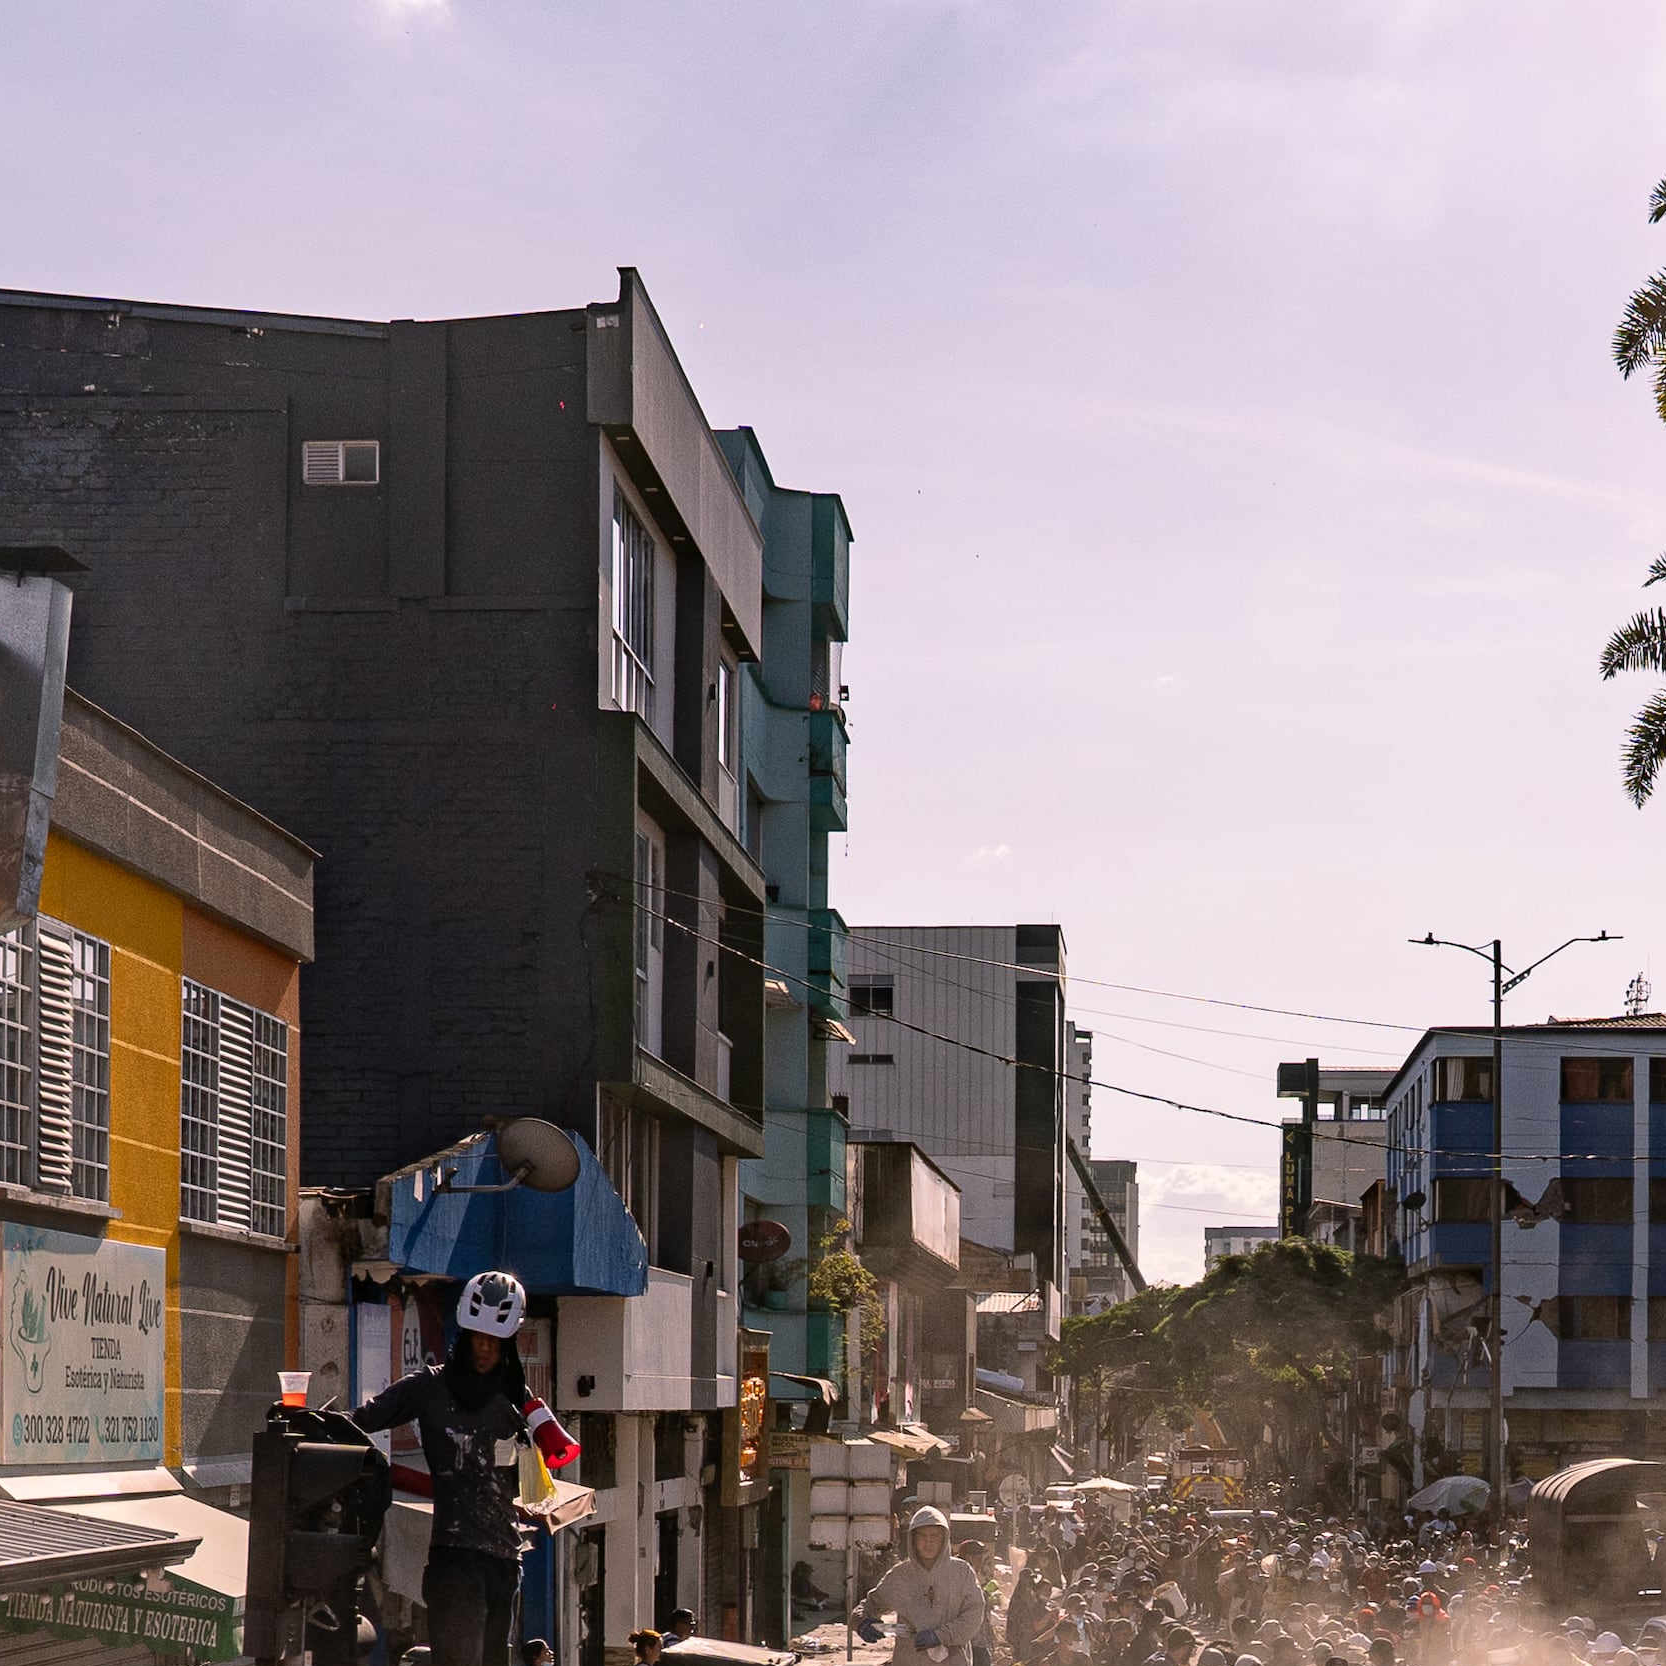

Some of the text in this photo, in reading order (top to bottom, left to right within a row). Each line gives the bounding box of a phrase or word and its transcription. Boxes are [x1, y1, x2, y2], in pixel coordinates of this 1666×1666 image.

[46, 1266, 162, 1336] Vive Natural Live
[90, 1336, 122, 1361] TIENDA
[65, 1365, 145, 1395] Esotérica y Naturista
[23, 1414, 159, 1444] 300 328 4722 321 752 1130
[72, 1578, 142, 1601] RODUCTOS
[6, 1591, 218, 1648] TIENDA NATURISTA Y ESOTERICA
